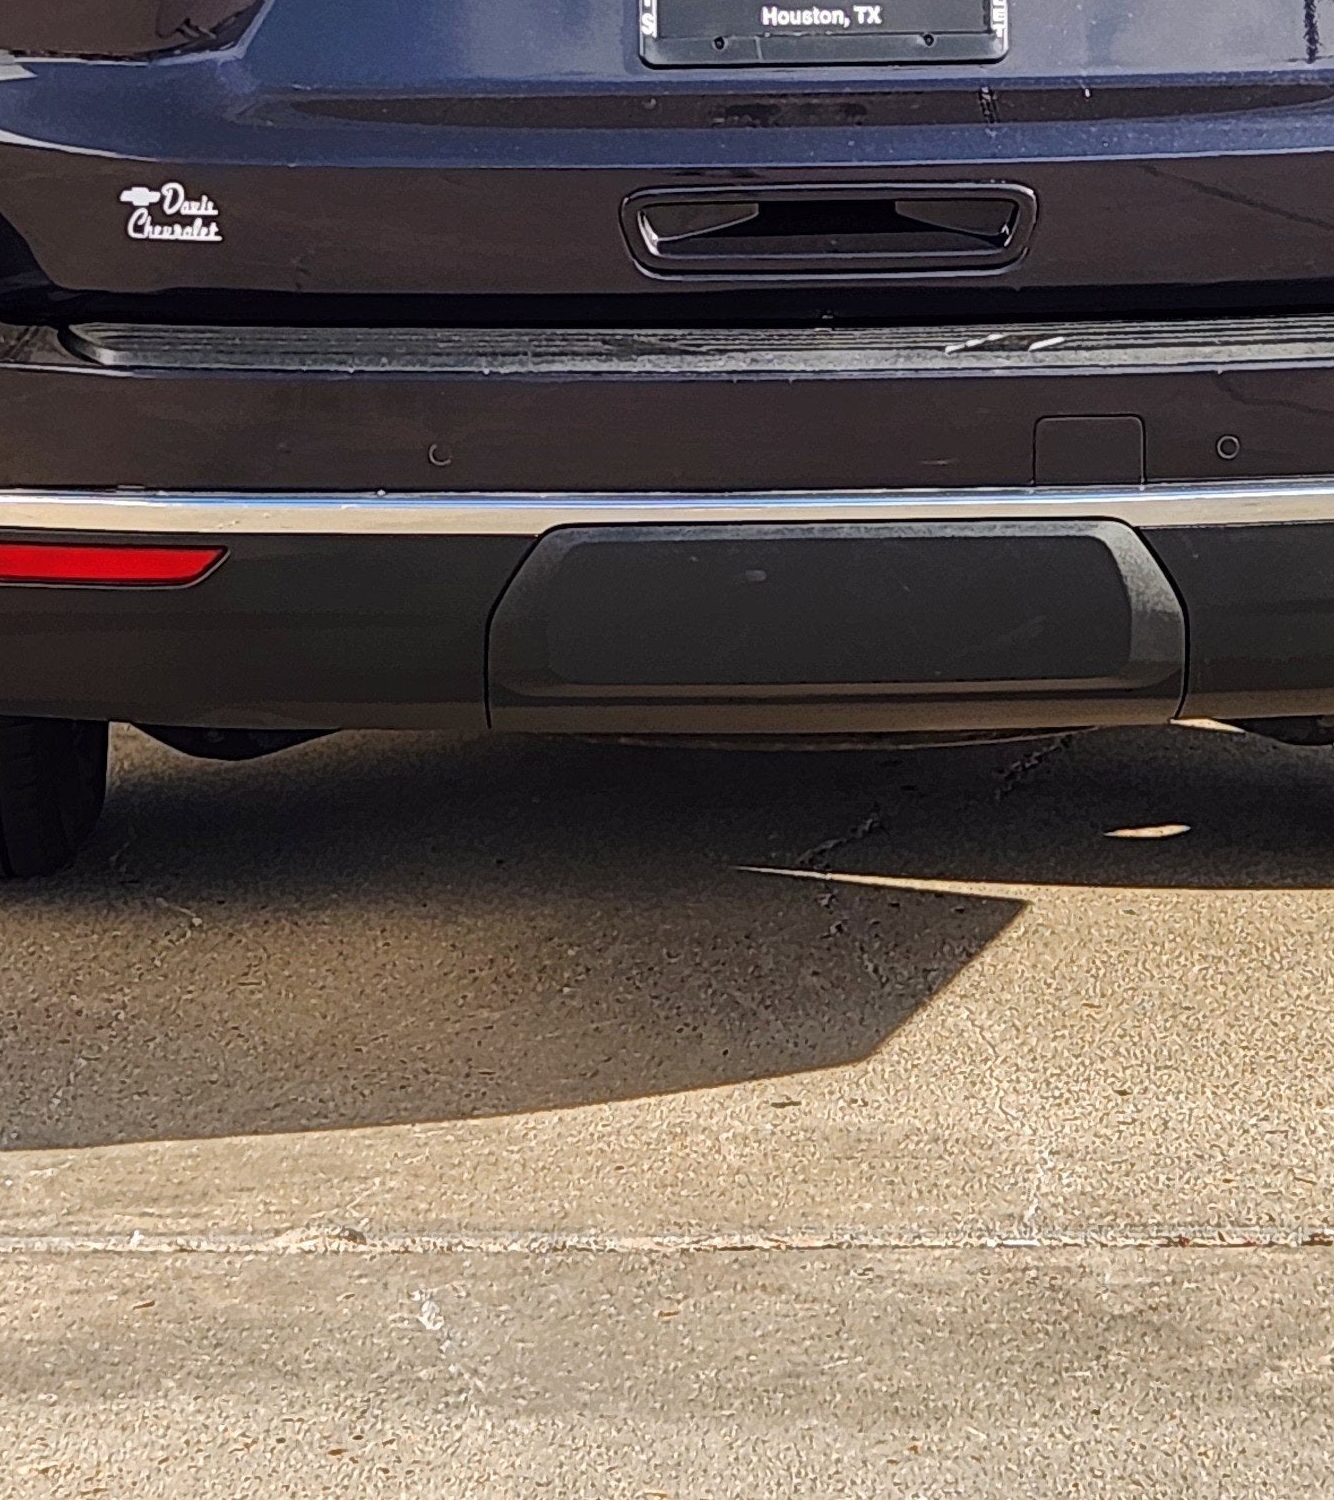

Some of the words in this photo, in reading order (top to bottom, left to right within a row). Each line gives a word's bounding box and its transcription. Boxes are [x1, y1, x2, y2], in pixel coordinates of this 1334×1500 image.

[762, 6, 849, 27] Houston,
[854, 4, 883, 24] TX
[128, 208, 222, 241] Chevrolet
